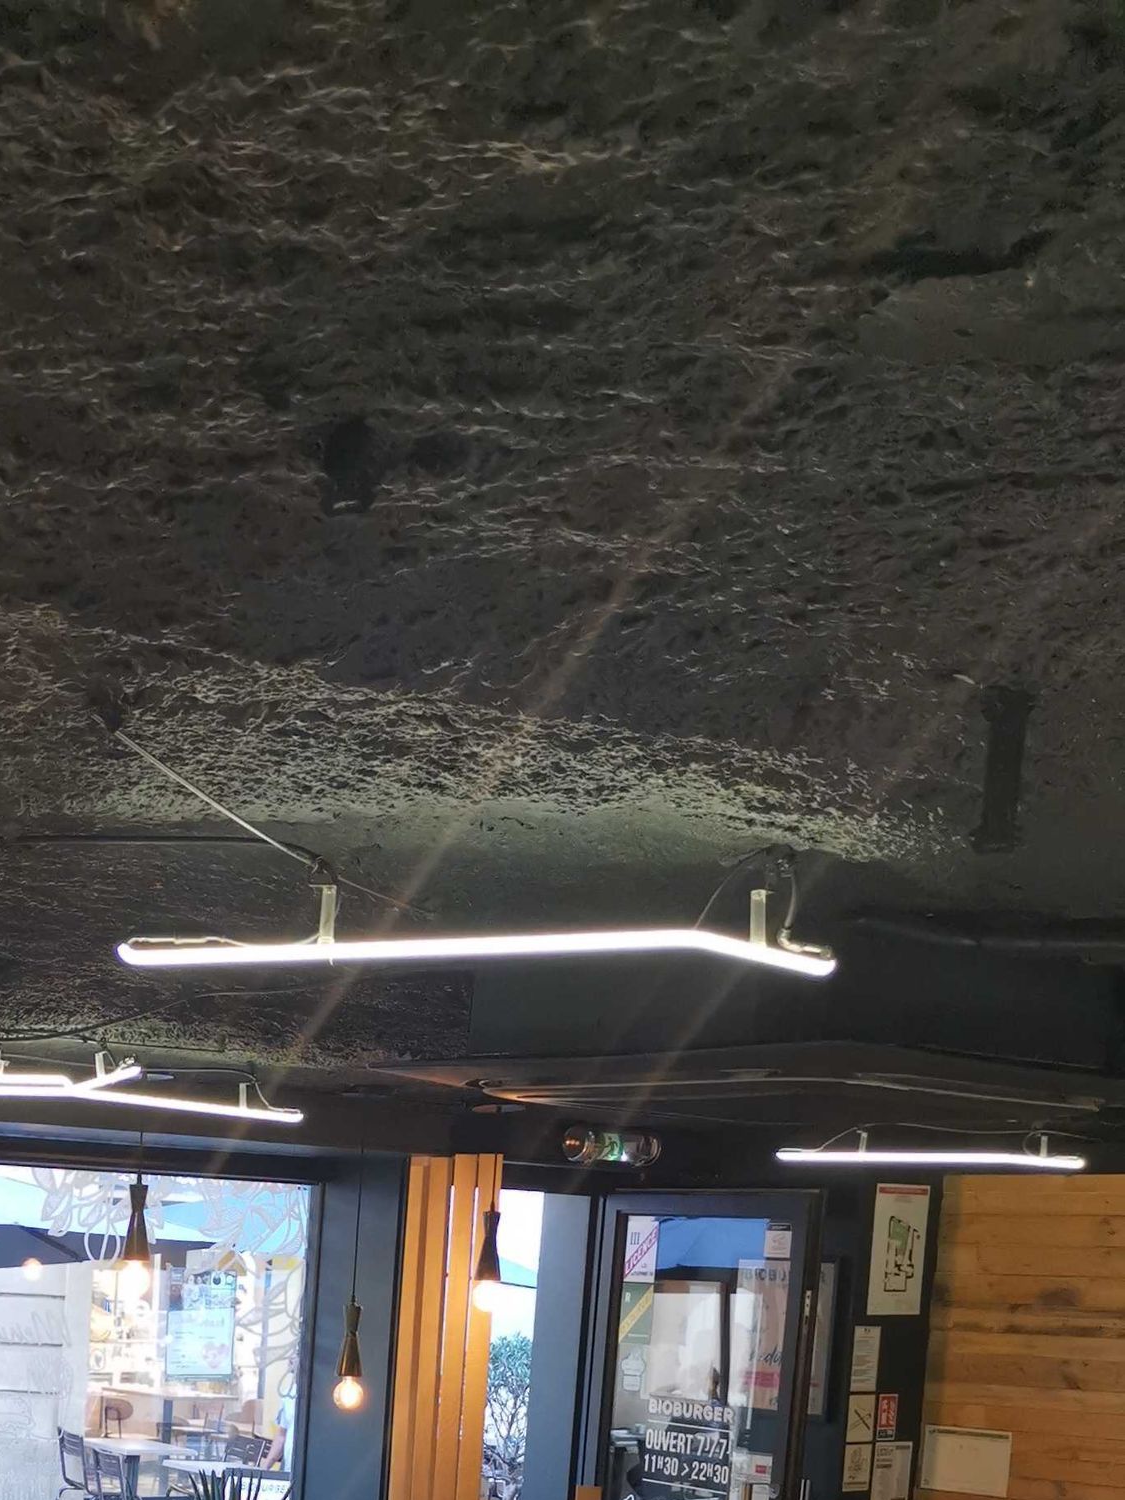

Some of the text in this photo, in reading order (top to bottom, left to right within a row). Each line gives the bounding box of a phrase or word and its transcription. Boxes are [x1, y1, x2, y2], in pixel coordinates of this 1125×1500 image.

[648, 1399, 735, 1424] BIOBURGER
[644, 1428, 694, 1455] OUVERT
[643, 1454, 679, 1477] 11H30
[691, 1461, 729, 1485] 22H30
